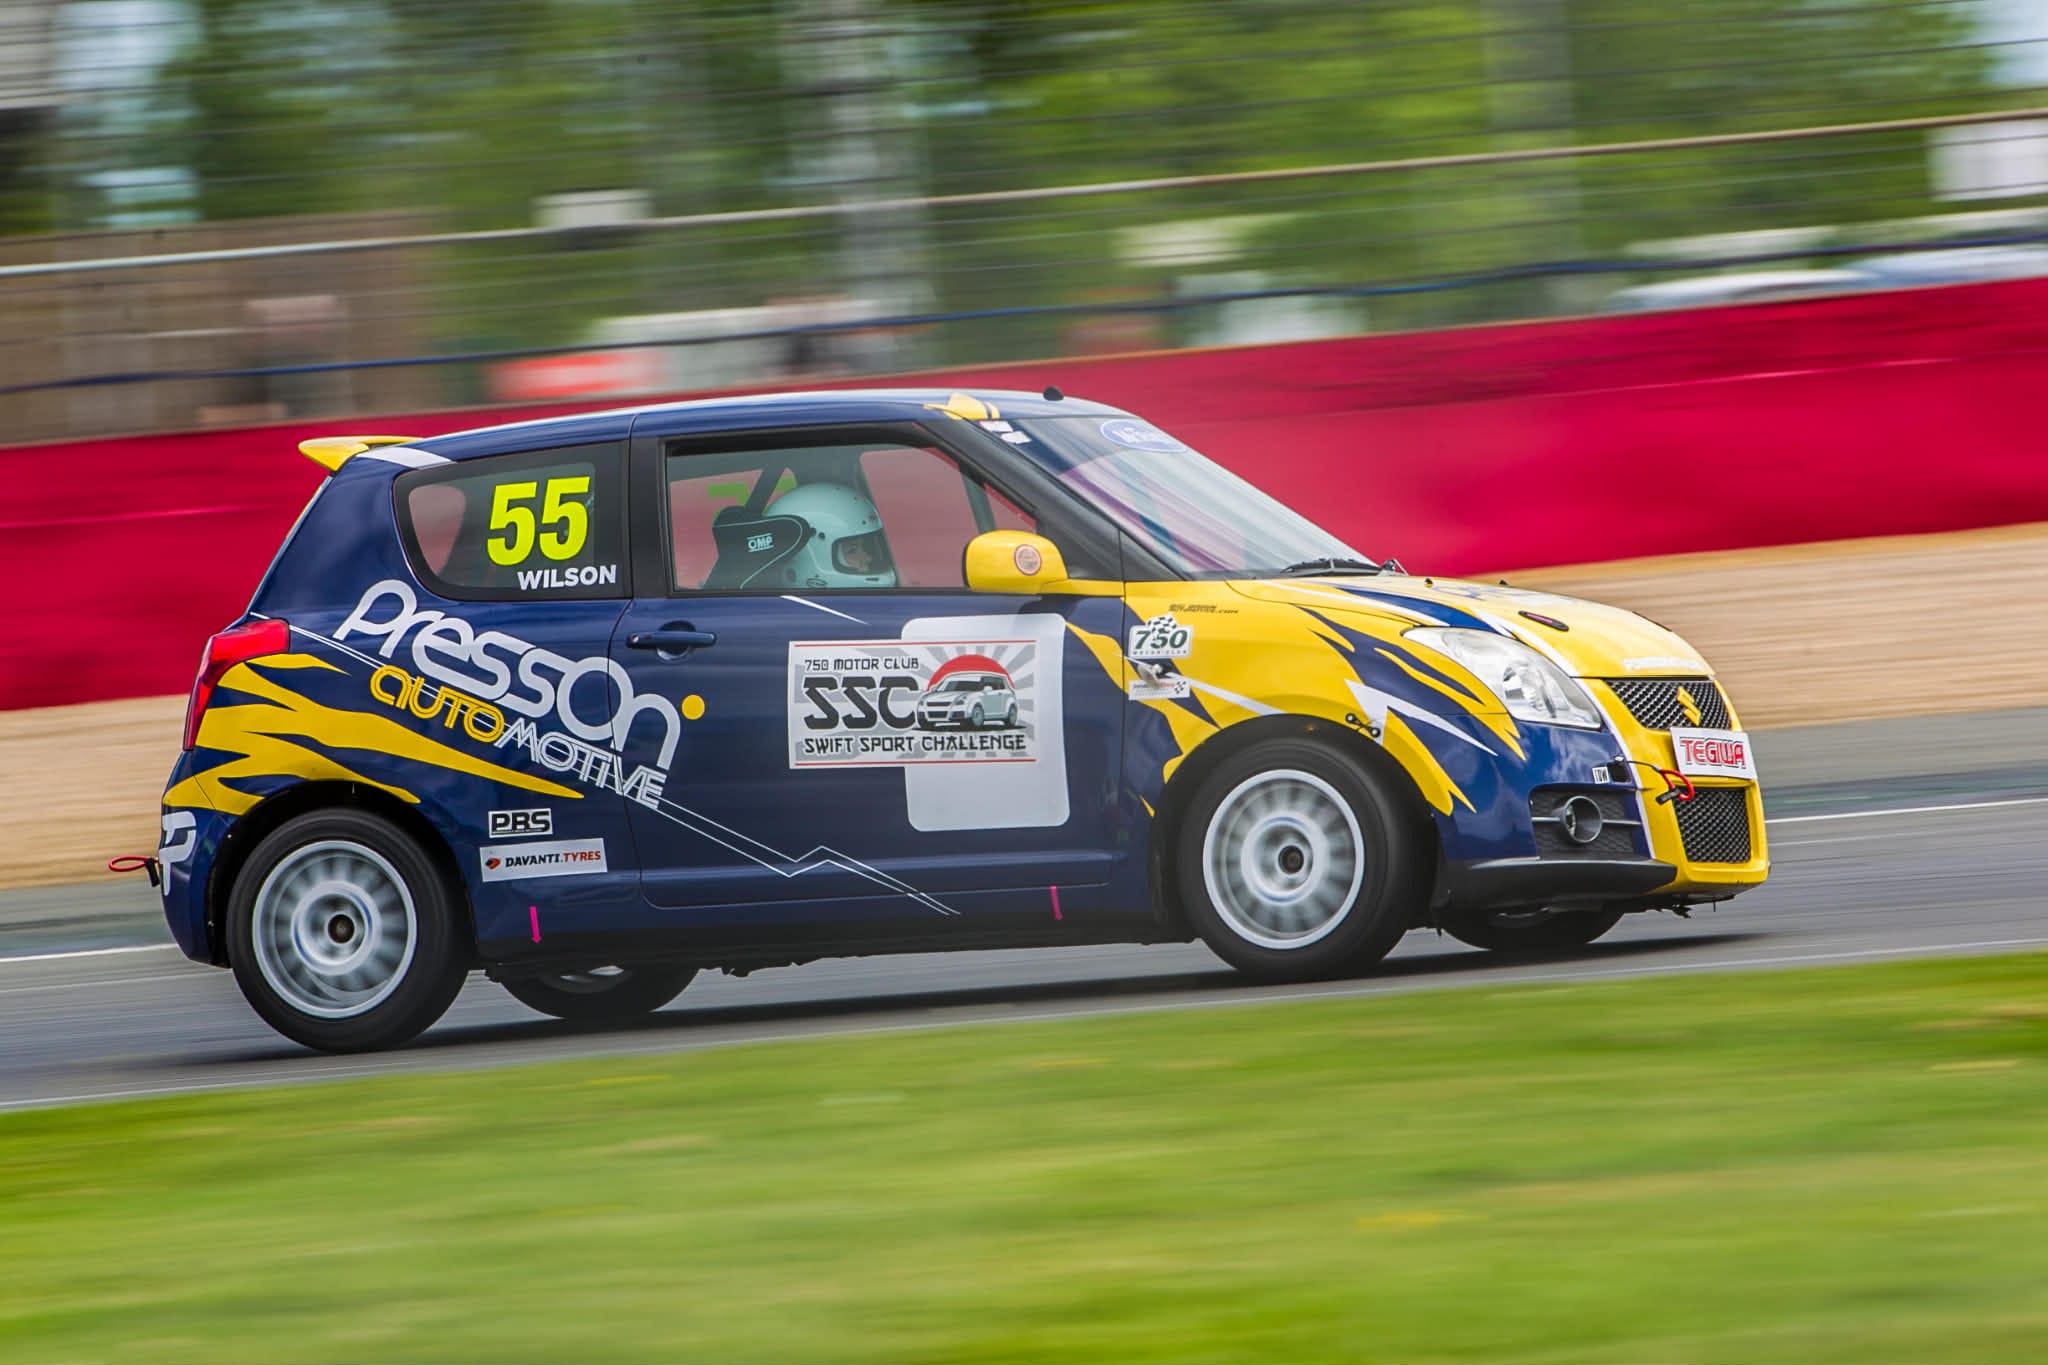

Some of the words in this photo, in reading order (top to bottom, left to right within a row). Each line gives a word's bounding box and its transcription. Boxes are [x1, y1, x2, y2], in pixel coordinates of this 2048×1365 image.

[486, 475, 591, 567] 55
[747, 535, 774, 550] OMP
[516, 564, 617, 591] WILSON
[1135, 629, 1189, 651] 750
[804, 658, 830, 672] 750
[833, 658, 880, 671] MOTOR
[884, 657, 920, 670] CLUB
[803, 675, 920, 730] SSC
[804, 736, 853, 754] SWIFT
[860, 735, 915, 753] SPORT
[921, 733, 1027, 751] CHALLENGE
[1680, 738, 1747, 767] TEGIWA
[491, 809, 551, 834] PBS
